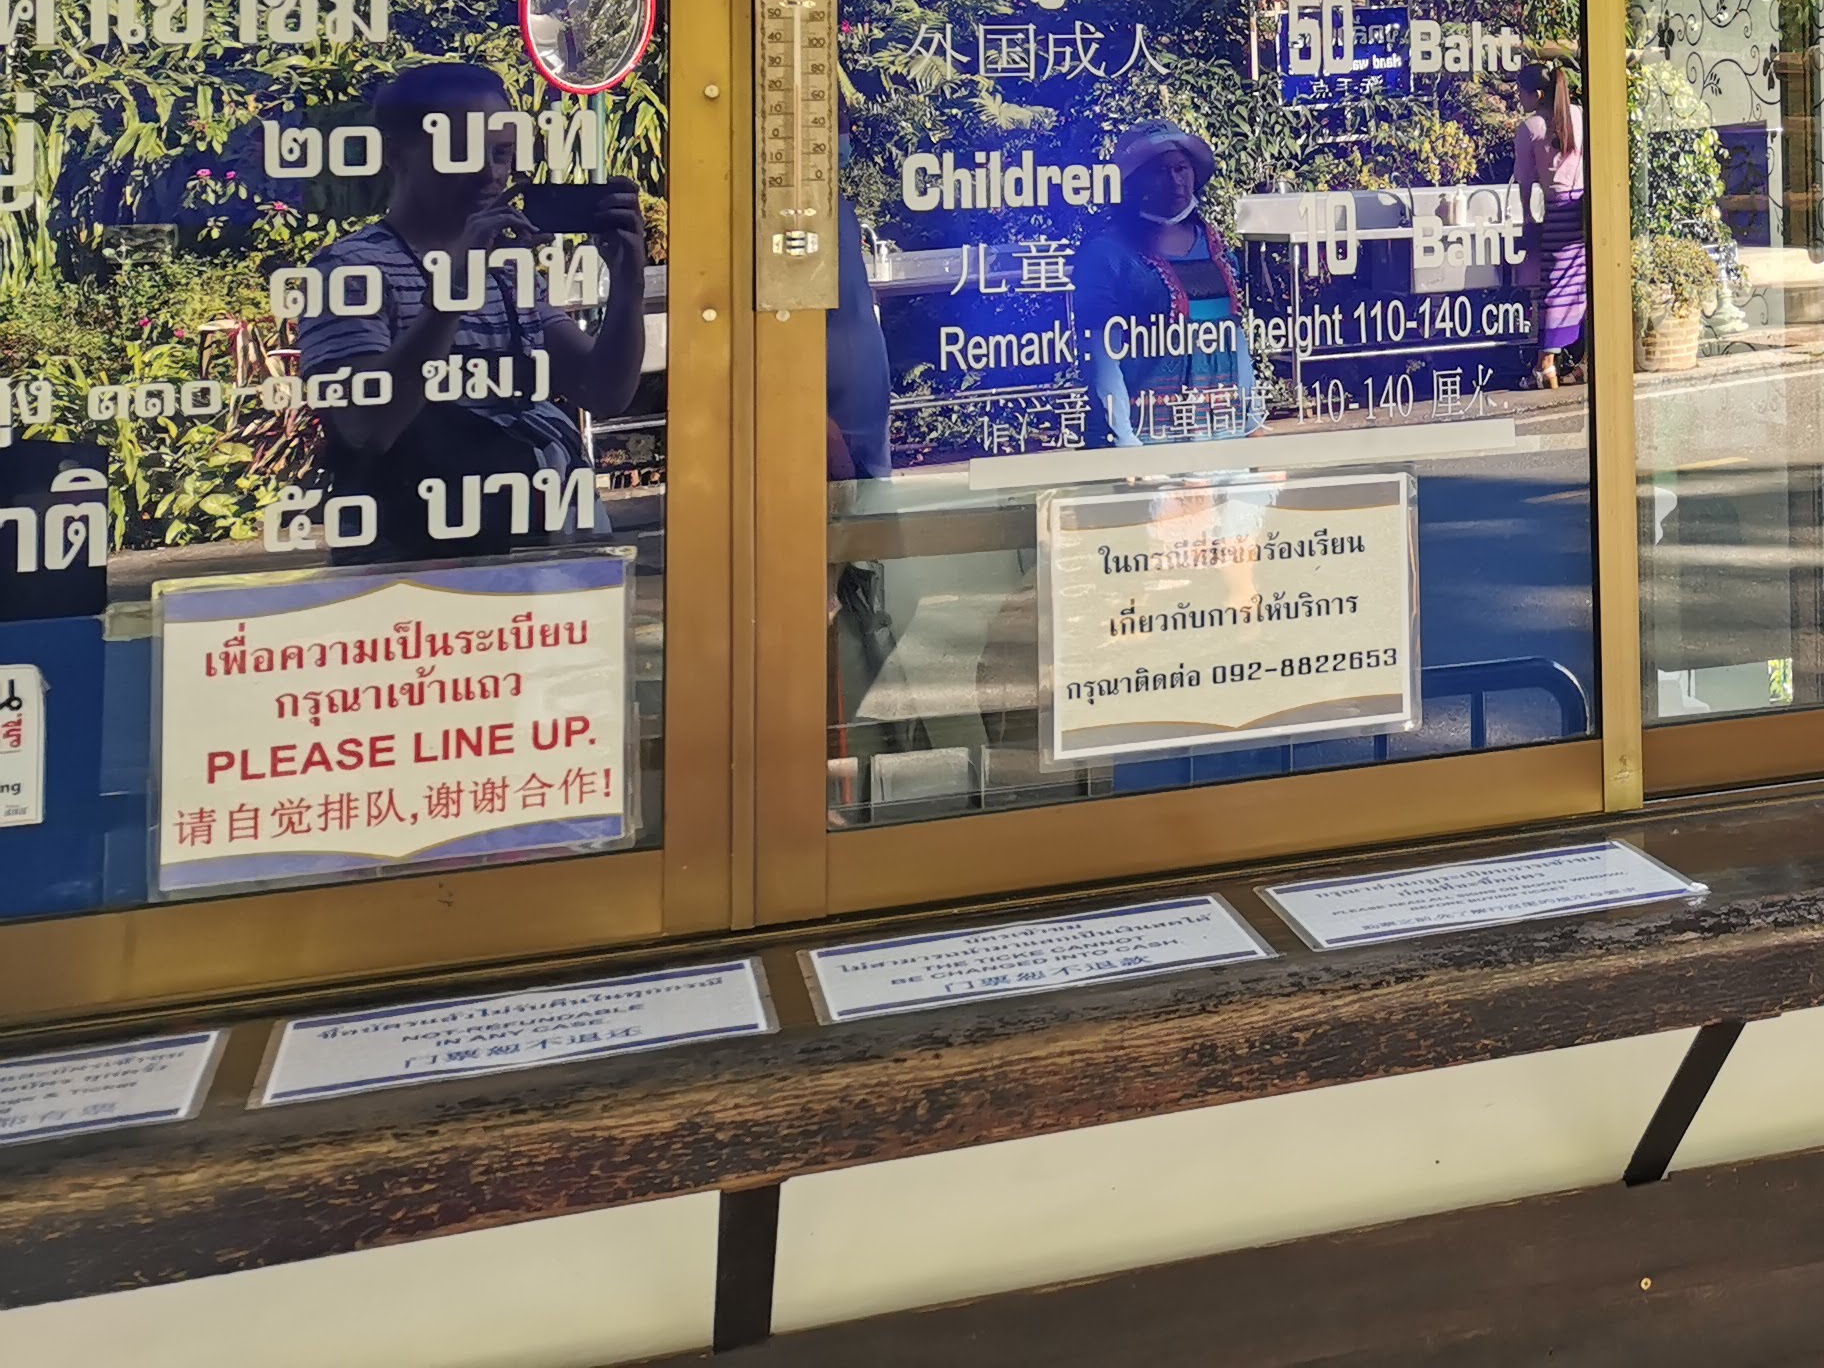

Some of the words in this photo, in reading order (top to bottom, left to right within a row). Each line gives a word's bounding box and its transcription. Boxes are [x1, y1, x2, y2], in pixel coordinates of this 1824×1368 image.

[903, 20, 1171, 81] 外国成人
[1410, 19, 1522, 74] Baht
[263, 119, 384, 180] ๒๐
[422, 107, 599, 175] บาท
[902, 150, 1121, 212] Children
[950, 234, 1077, 297] 儿童
[1298, 192, 1359, 276] 10
[1412, 213, 1527, 268] Baht
[269, 264, 384, 318] ๑๐
[423, 244, 601, 313] บาท
[940, 323, 1072, 373] Remark
[1104, 311, 1237, 361] Children
[1248, 303, 1345, 358] height
[1353, 295, 1473, 344] 110-140
[417, 466, 596, 542] บาท
[1110, 591, 1359, 637] เกี่ยวกับการให้บริการ
[205, 616, 589, 678] เพื่อความเป็นระเบียบ
[1066, 663, 1201, 705] กรุณาติดต่อ
[1212, 648, 1398, 685] 092-8822653
[275, 664, 523, 727] กรุณาเข้าแถว
[206, 734, 396, 784] PLEASE
[413, 722, 515, 763] LINE
[531, 715, 598, 751] UP.
